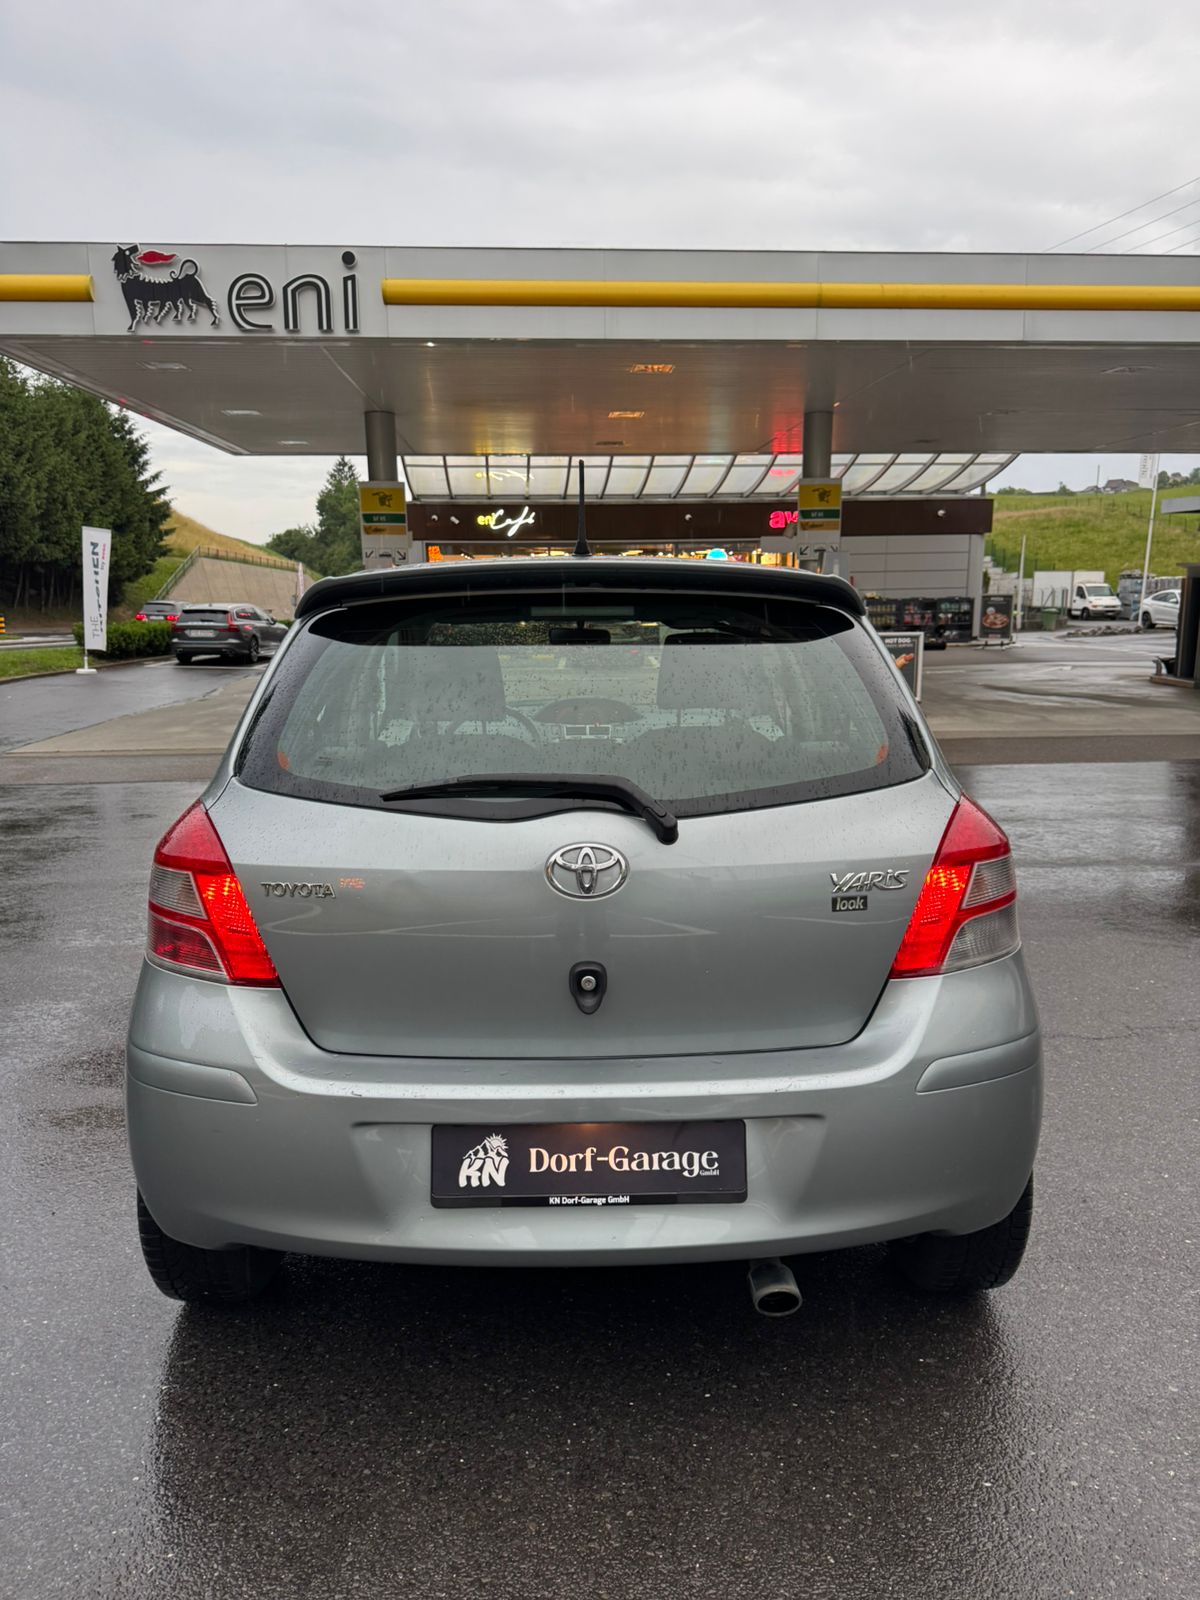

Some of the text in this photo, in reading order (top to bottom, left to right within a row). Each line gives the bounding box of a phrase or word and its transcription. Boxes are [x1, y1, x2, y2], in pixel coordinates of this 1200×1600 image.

[227, 250, 359, 332] eni
[769, 511, 799, 528] av
[261, 881, 336, 898] TOYOTA
[836, 896, 864, 911] look
[529, 1146, 719, 1178] Dorf-Garage
[458, 1156, 509, 1188] KN
[562, 1196, 606, 1205] Dorf-Garage
[608, 1195, 629, 1203] GmbH
